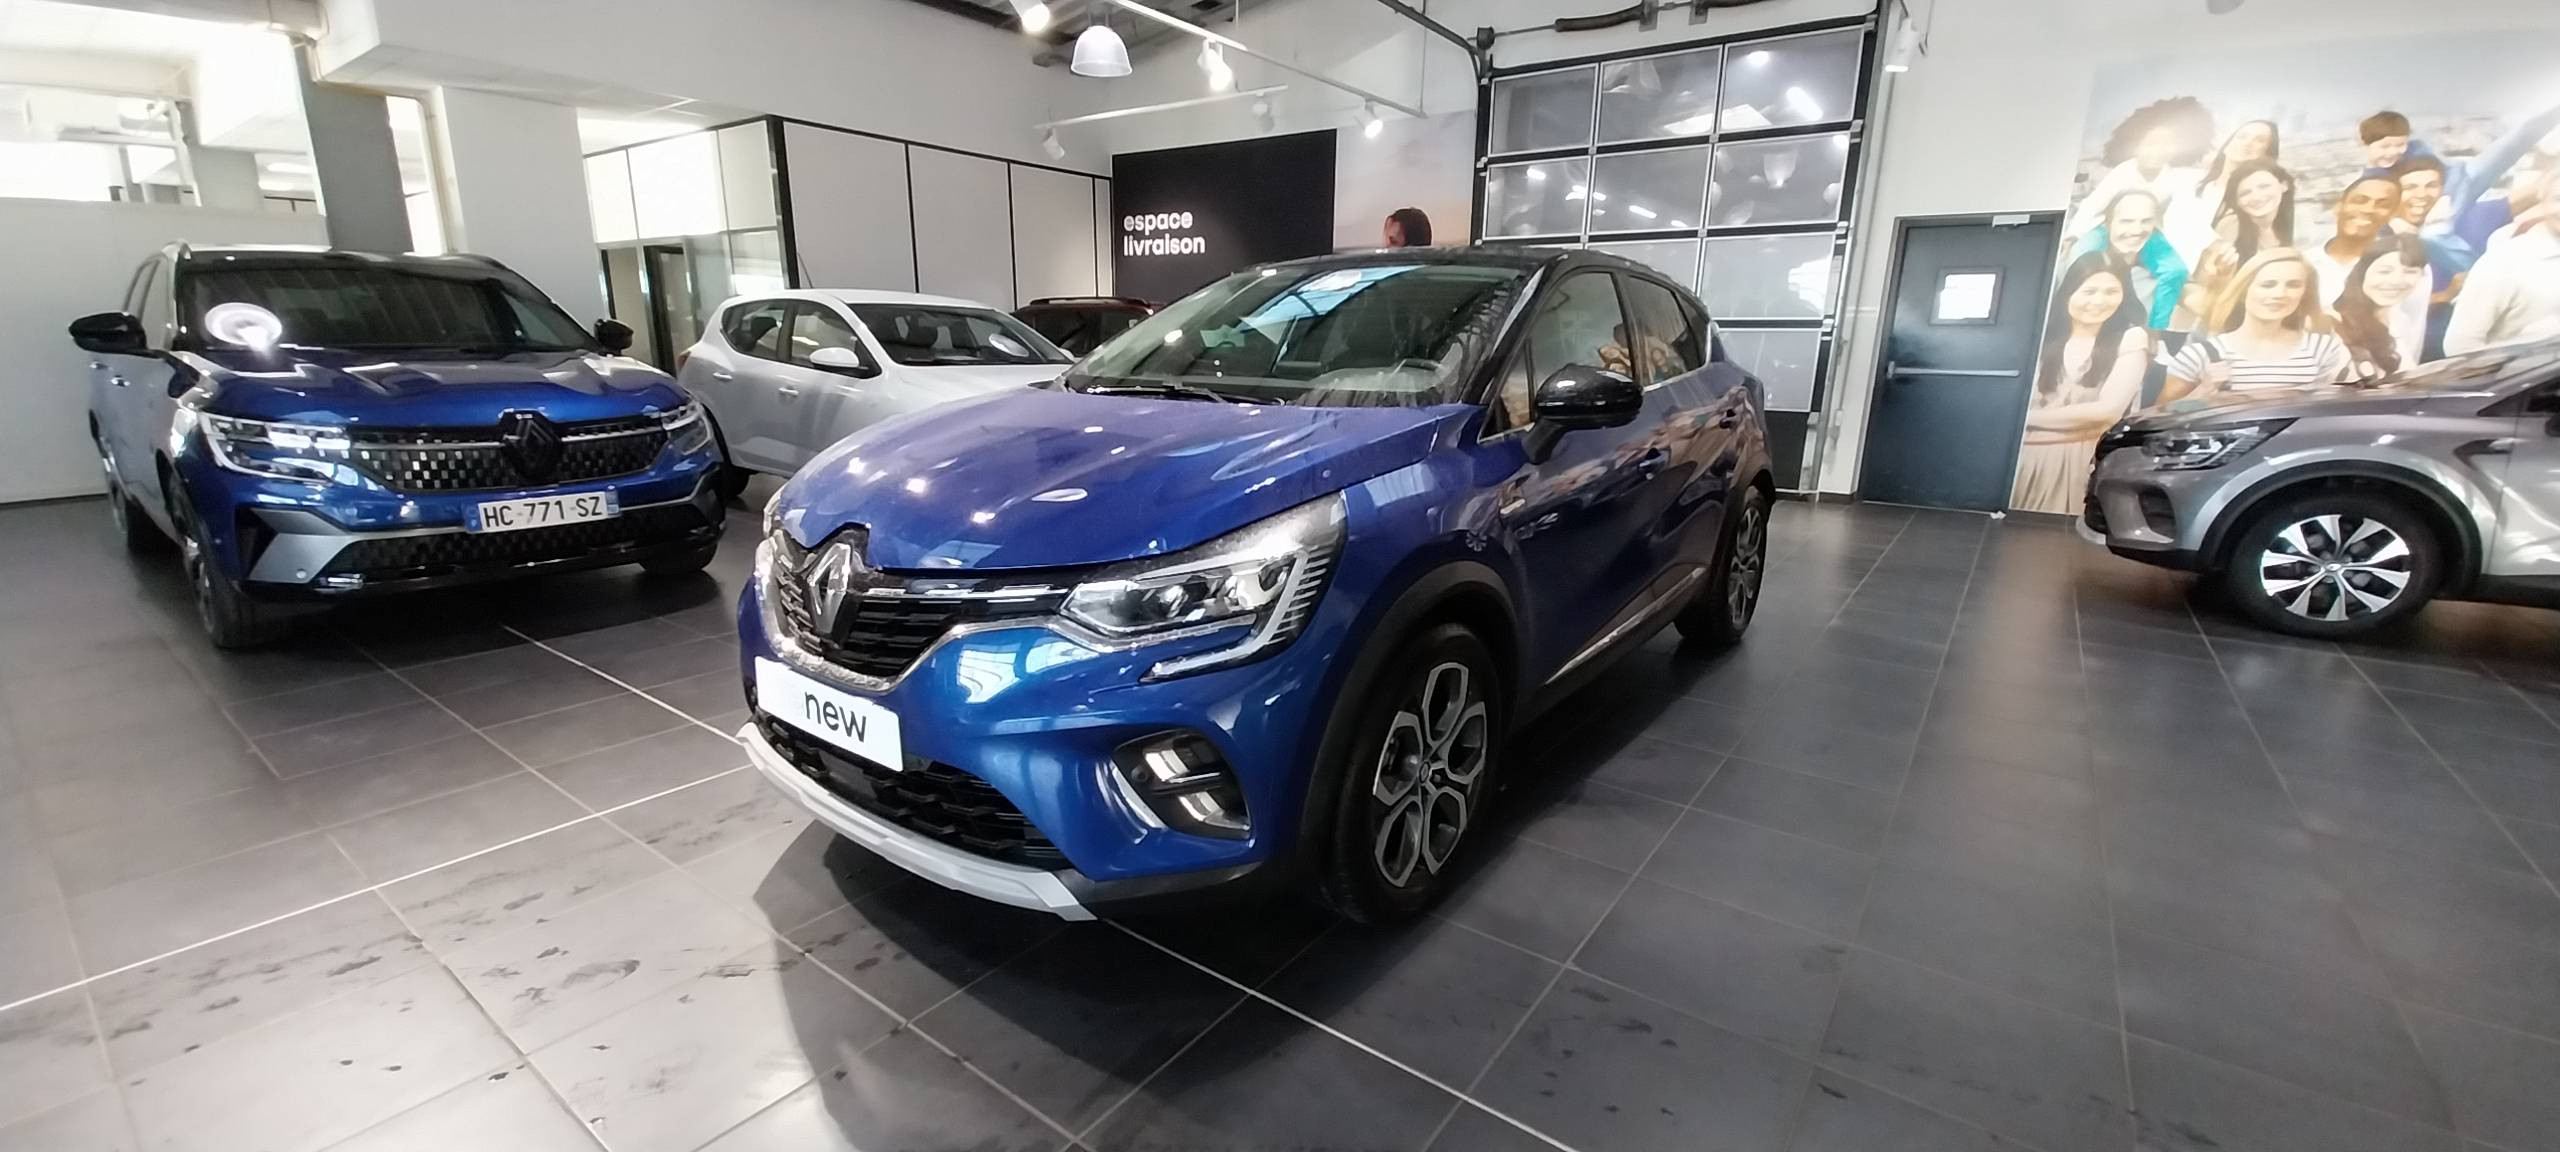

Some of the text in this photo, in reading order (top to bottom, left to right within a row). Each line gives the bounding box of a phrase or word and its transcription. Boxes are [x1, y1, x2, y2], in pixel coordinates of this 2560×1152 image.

[1123, 211, 1193, 236] espace
[1123, 233, 1206, 256] livraison
[804, 692, 867, 743] new
